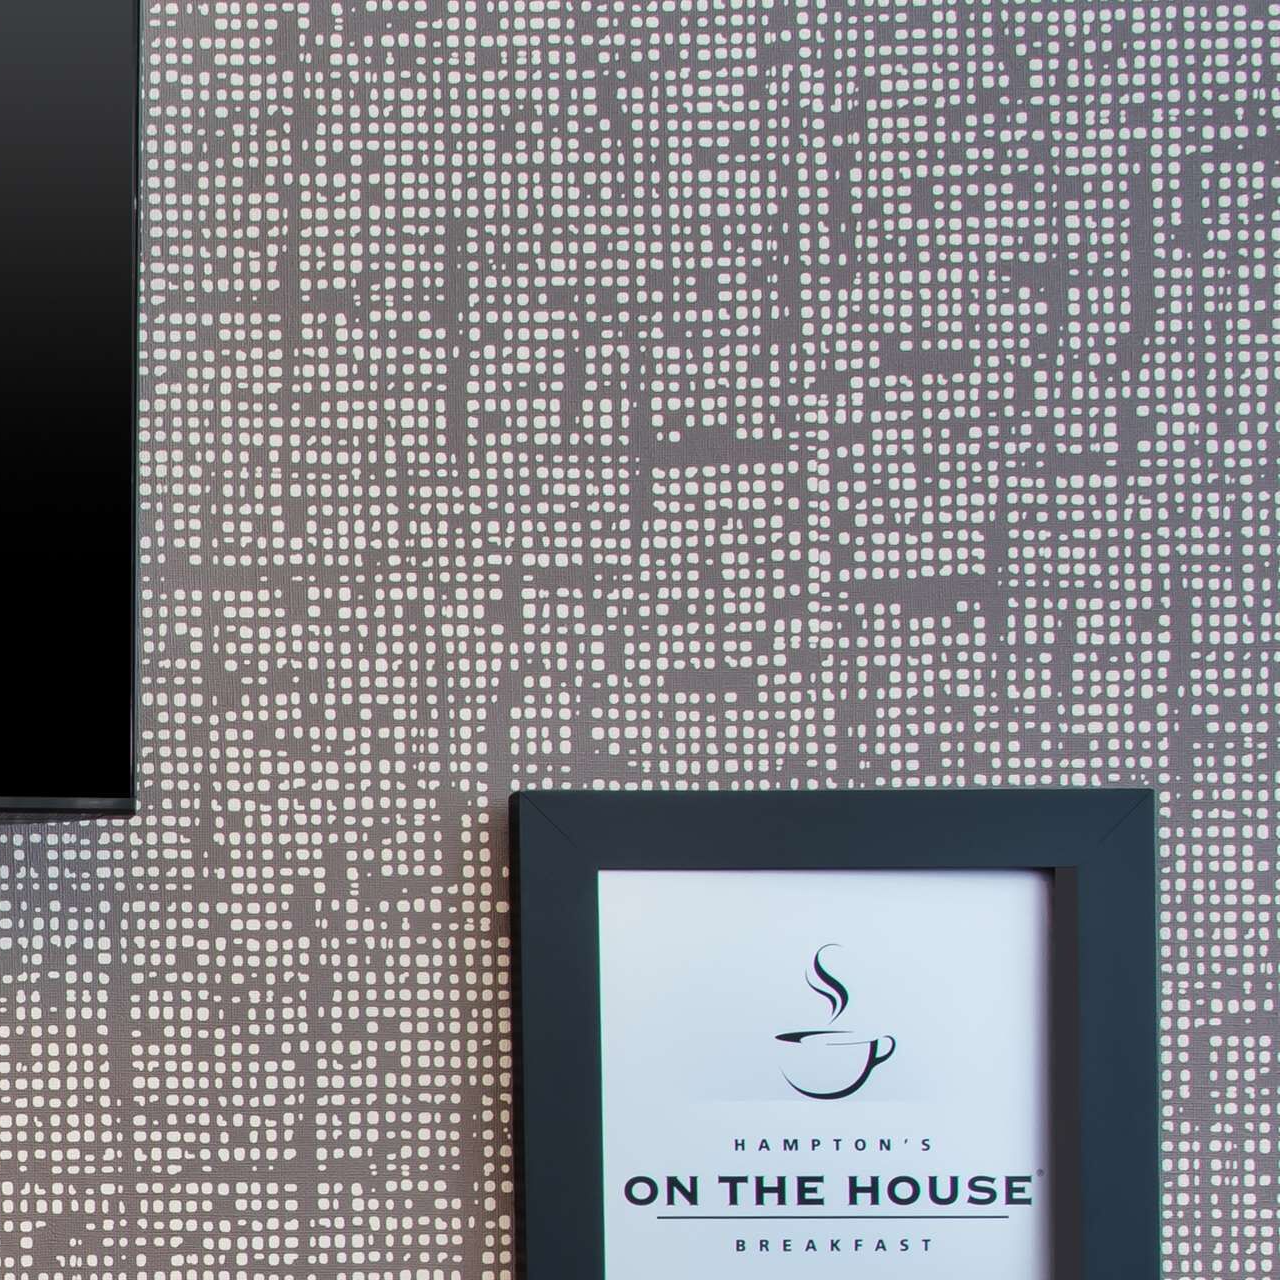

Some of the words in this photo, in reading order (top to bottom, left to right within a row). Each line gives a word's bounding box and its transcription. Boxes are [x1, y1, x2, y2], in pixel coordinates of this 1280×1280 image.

[734, 1138, 932, 1152] HAMPTON'S
[623, 1175, 700, 1207] ON
[718, 1175, 826, 1207] THE
[735, 1238, 934, 1253] BREAKFAST
